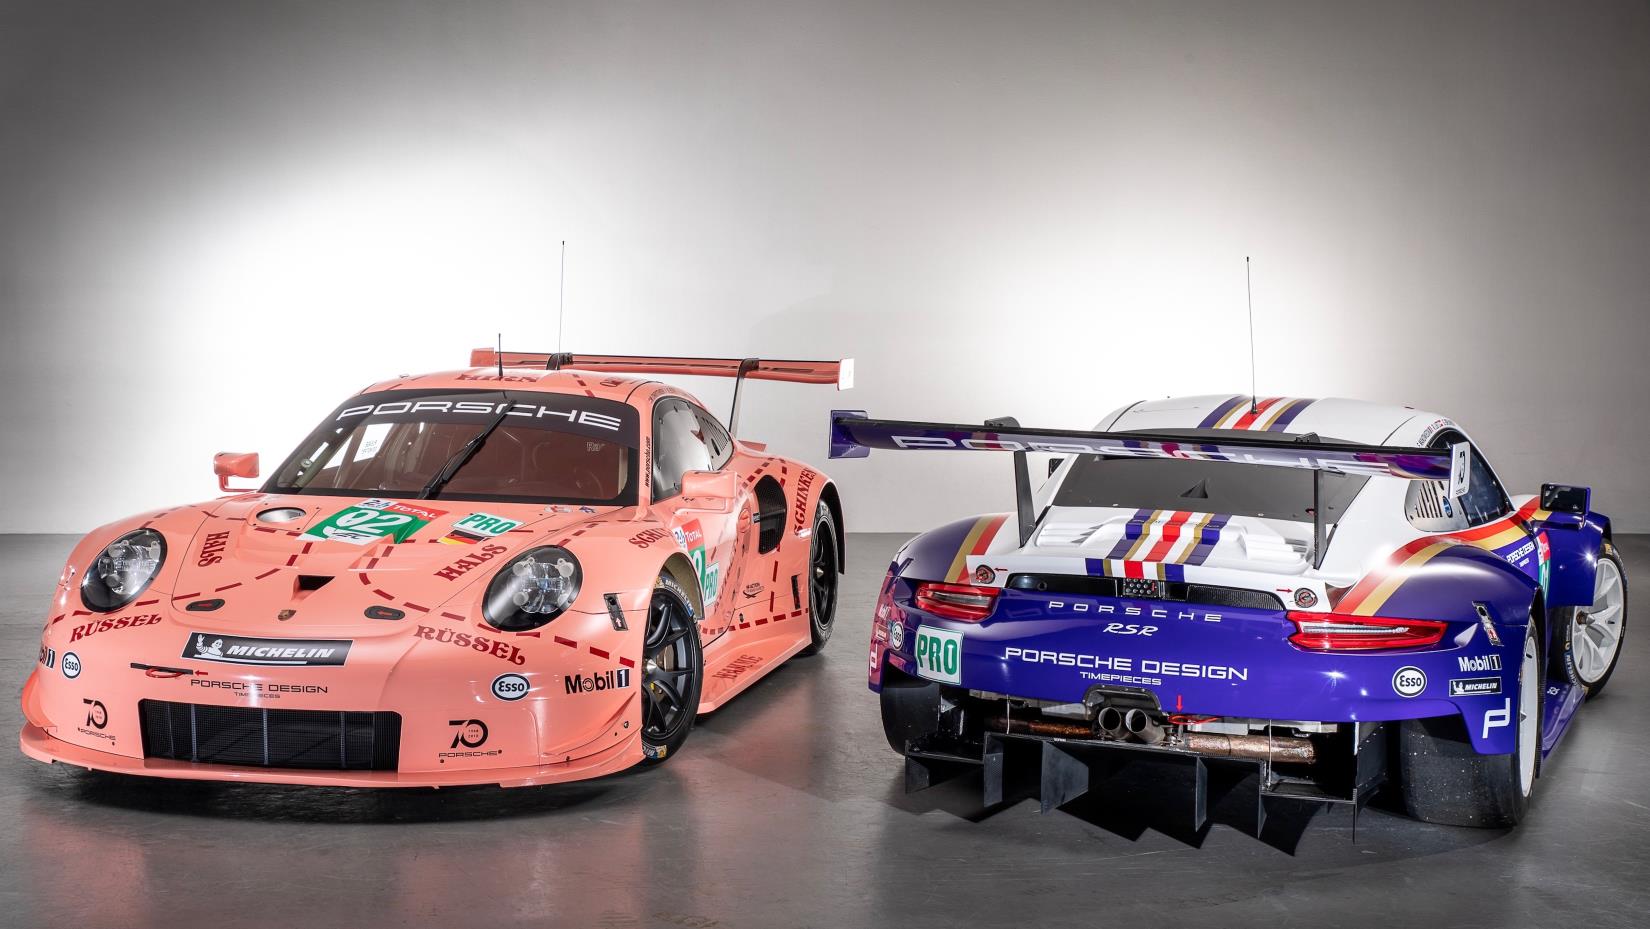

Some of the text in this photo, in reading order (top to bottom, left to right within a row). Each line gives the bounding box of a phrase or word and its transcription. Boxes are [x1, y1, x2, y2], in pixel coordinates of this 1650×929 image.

[336, 401, 622, 431] PORSCHE
[393, 505, 438, 519] TOTAL
[458, 513, 518, 535] PRO
[685, 529, 702, 543] TOTAL
[197, 531, 230, 567] HALS
[433, 543, 508, 582] HALS
[705, 569, 718, 601] PRO
[1049, 601, 1222, 622] PORSCHE
[1103, 622, 1159, 637] RSR
[226, 645, 335, 658] MICHELIN
[414, 625, 526, 665] RÜSSEL
[917, 633, 958, 675] PRO
[64, 657, 79, 672] Esso
[1005, 647, 1248, 681] PORSCHE DESIGN
[1458, 655, 1491, 672] Mobil
[191, 679, 328, 693] PORSCHE DESIGN
[498, 680, 525, 692] Esso
[565, 671, 614, 694] Mobil
[1080, 671, 1162, 686] TIMEPIECES
[1399, 674, 1422, 687] Esso
[1464, 682, 1498, 691] MICHELIN
[80, 728, 116, 740] PORSCHE
[449, 719, 489, 749] 70
